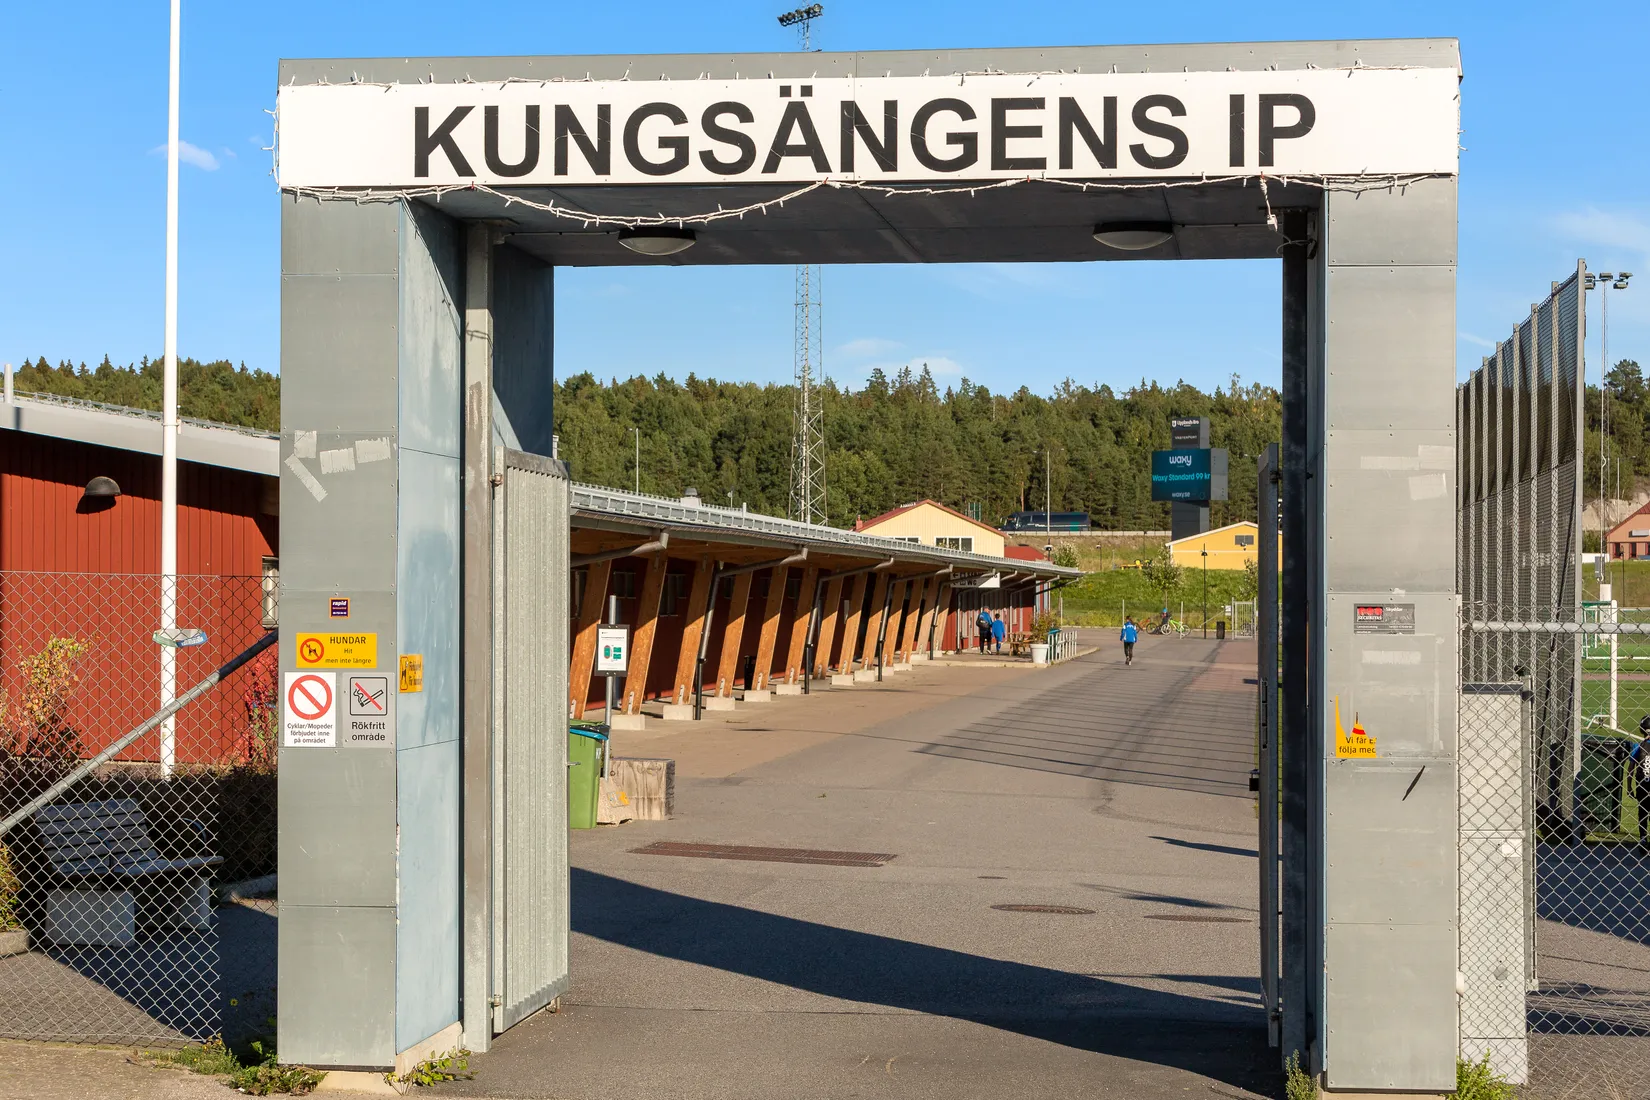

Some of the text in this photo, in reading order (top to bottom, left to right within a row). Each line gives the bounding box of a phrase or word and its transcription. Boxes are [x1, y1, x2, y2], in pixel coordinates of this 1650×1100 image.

[414, 85, 1316, 178] KUNGSÄNGENS IP
[1169, 454, 1192, 466] waxy
[1152, 472, 1210, 482] Waxy Standard 99 kr
[330, 636, 367, 645] HUNDAR
[353, 657, 371, 665] längre
[287, 722, 333, 730] Cyklar/Mopeder
[351, 721, 386, 730] Rökfritt
[351, 732, 386, 741] område
[1345, 736, 1354, 744] Vi
[1356, 736, 1367, 744] får
[1339, 746, 1357, 755] följa
